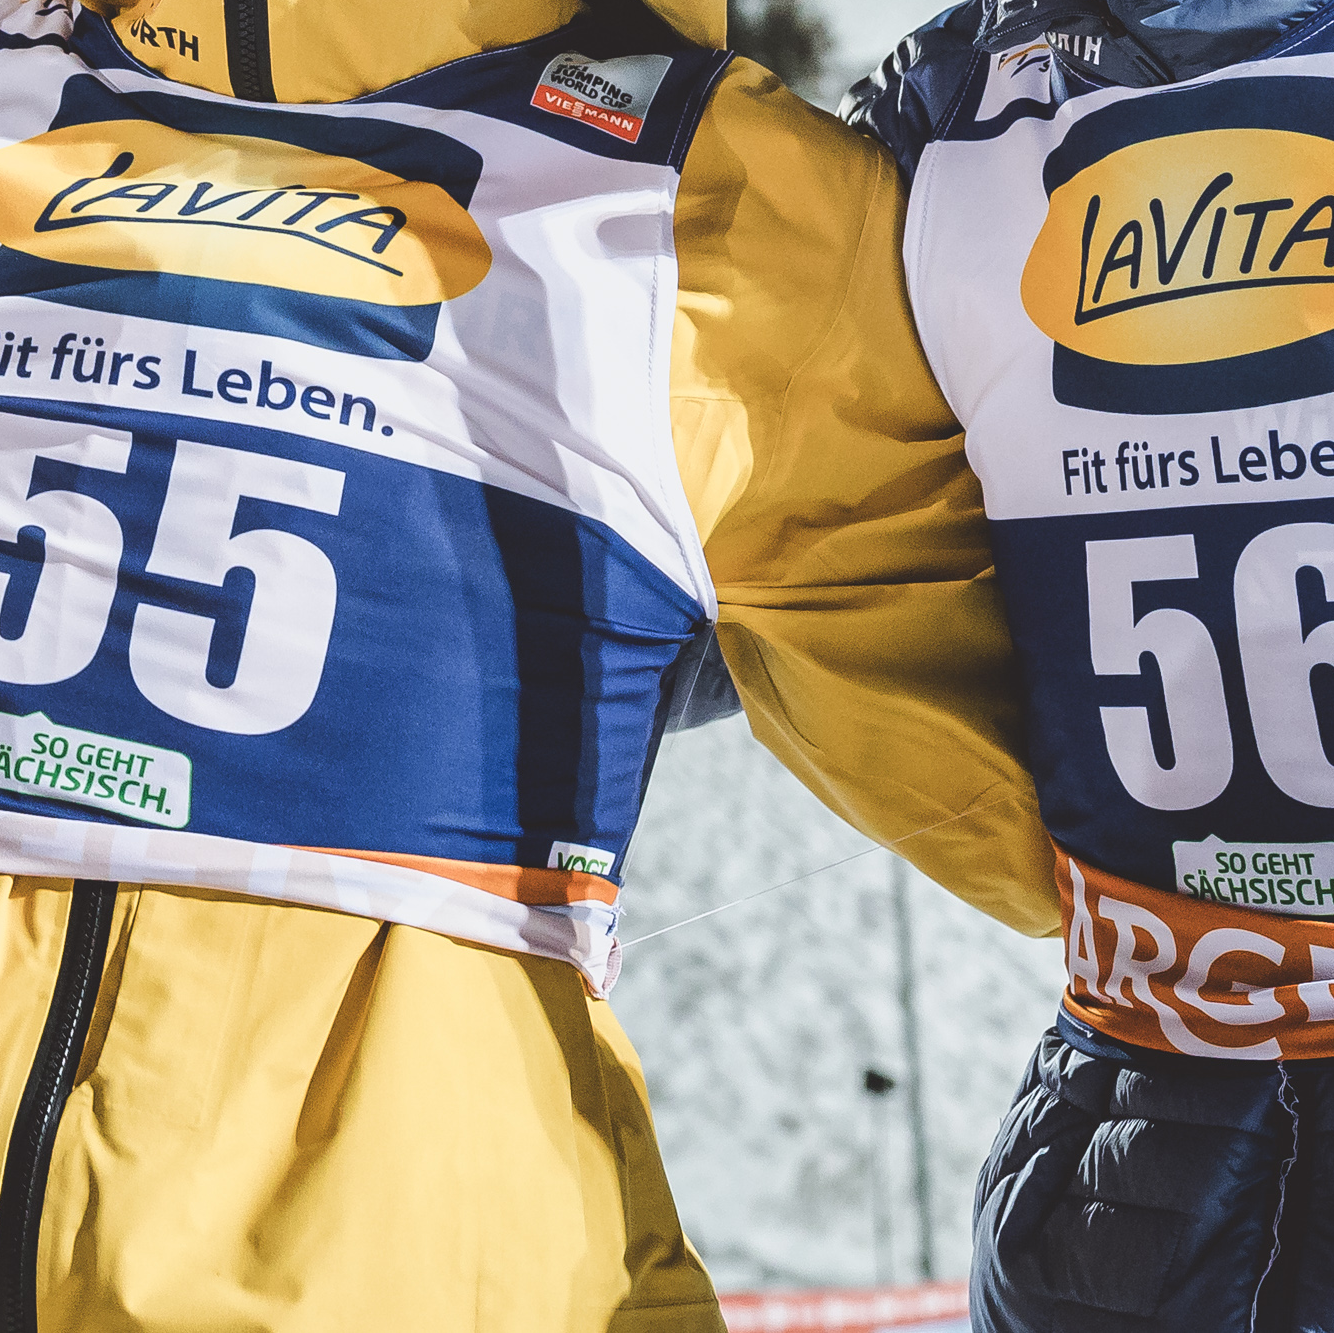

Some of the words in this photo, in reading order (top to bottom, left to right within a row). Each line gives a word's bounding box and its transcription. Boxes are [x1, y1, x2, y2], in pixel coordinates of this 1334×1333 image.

[551, 74, 599, 100] WORLD
[600, 95, 628, 109] CUP
[553, 65, 633, 104] JUMPING
[545, 92, 634, 132] VIESSMANN
[50, 333, 161, 389] fürs
[181, 349, 395, 436] Leben.
[1061, 448, 1108, 496] Fit
[1115, 439, 1200, 491] fürs
[31, 732, 69, 759] SO
[76, 743, 154, 778] GEHT
[1215, 852, 1247, 874] SO
[1252, 853, 1315, 876] GEHT
